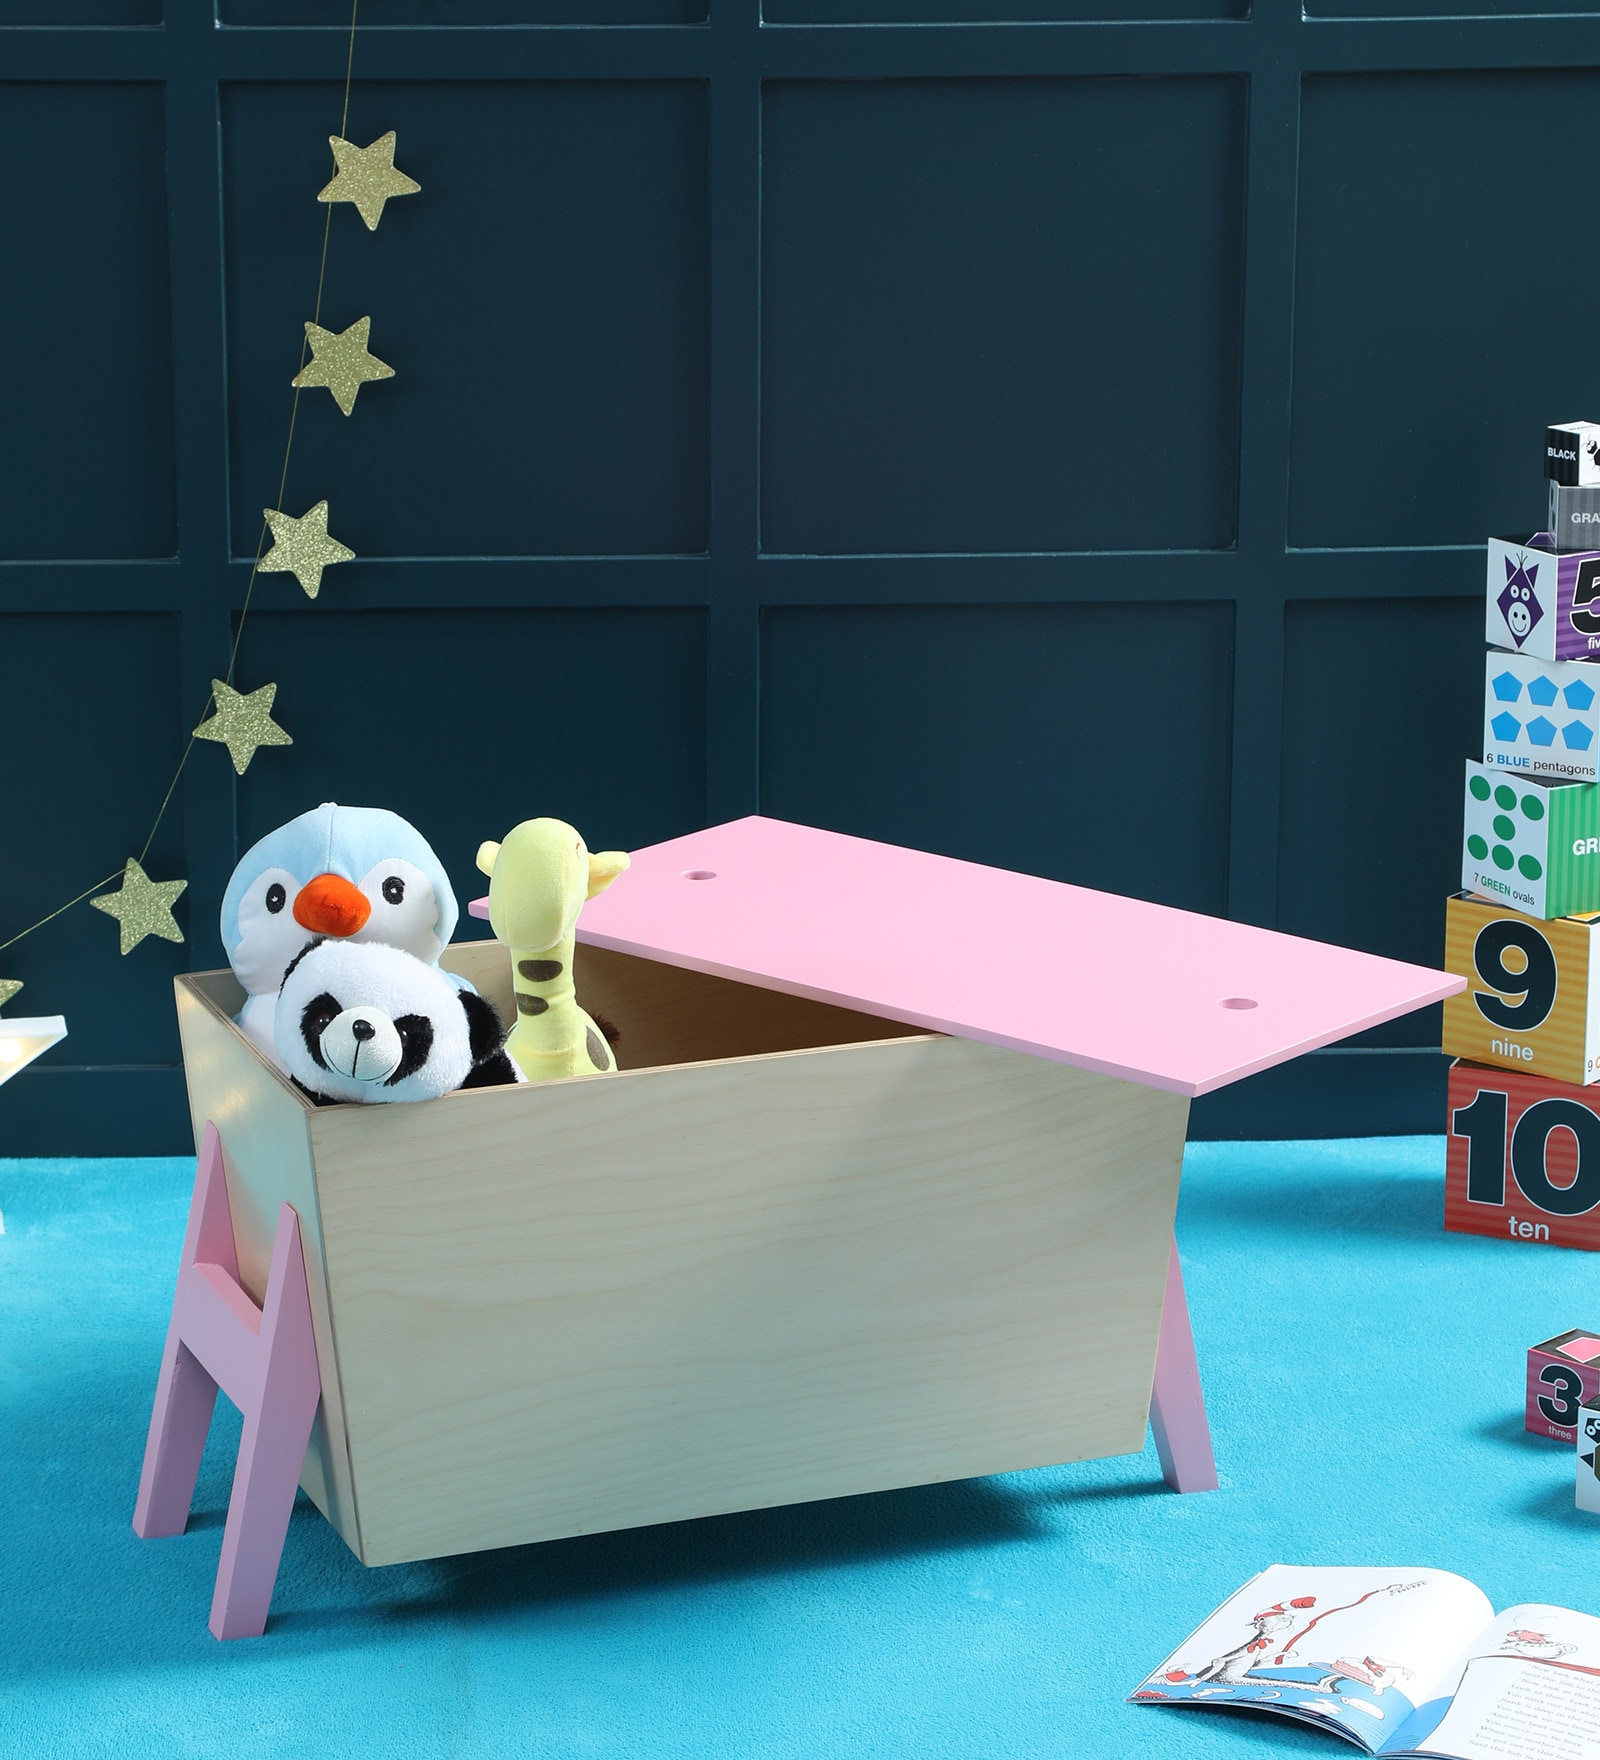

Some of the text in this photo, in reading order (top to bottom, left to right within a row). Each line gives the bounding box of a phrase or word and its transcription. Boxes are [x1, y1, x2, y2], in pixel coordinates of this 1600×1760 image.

[1547, 447, 1576, 461] BLACK
[1571, 512, 1600, 524] GRA
[1569, 557, 1600, 636] 5
[1486, 753, 1596, 776] 6 BLUE pentagons
[1572, 837, 1600, 856] GR
[1474, 872, 1535, 906] 7 GREEN ovals
[1472, 918, 1558, 1032] 9
[1491, 1038, 1534, 1062] nine
[1587, 1059, 1593, 1073] 9
[1452, 1088, 1600, 1217] 10
[1508, 1215, 1550, 1241] ten
[1537, 1363, 1584, 1429] 3
[1548, 1424, 1572, 1440] three
